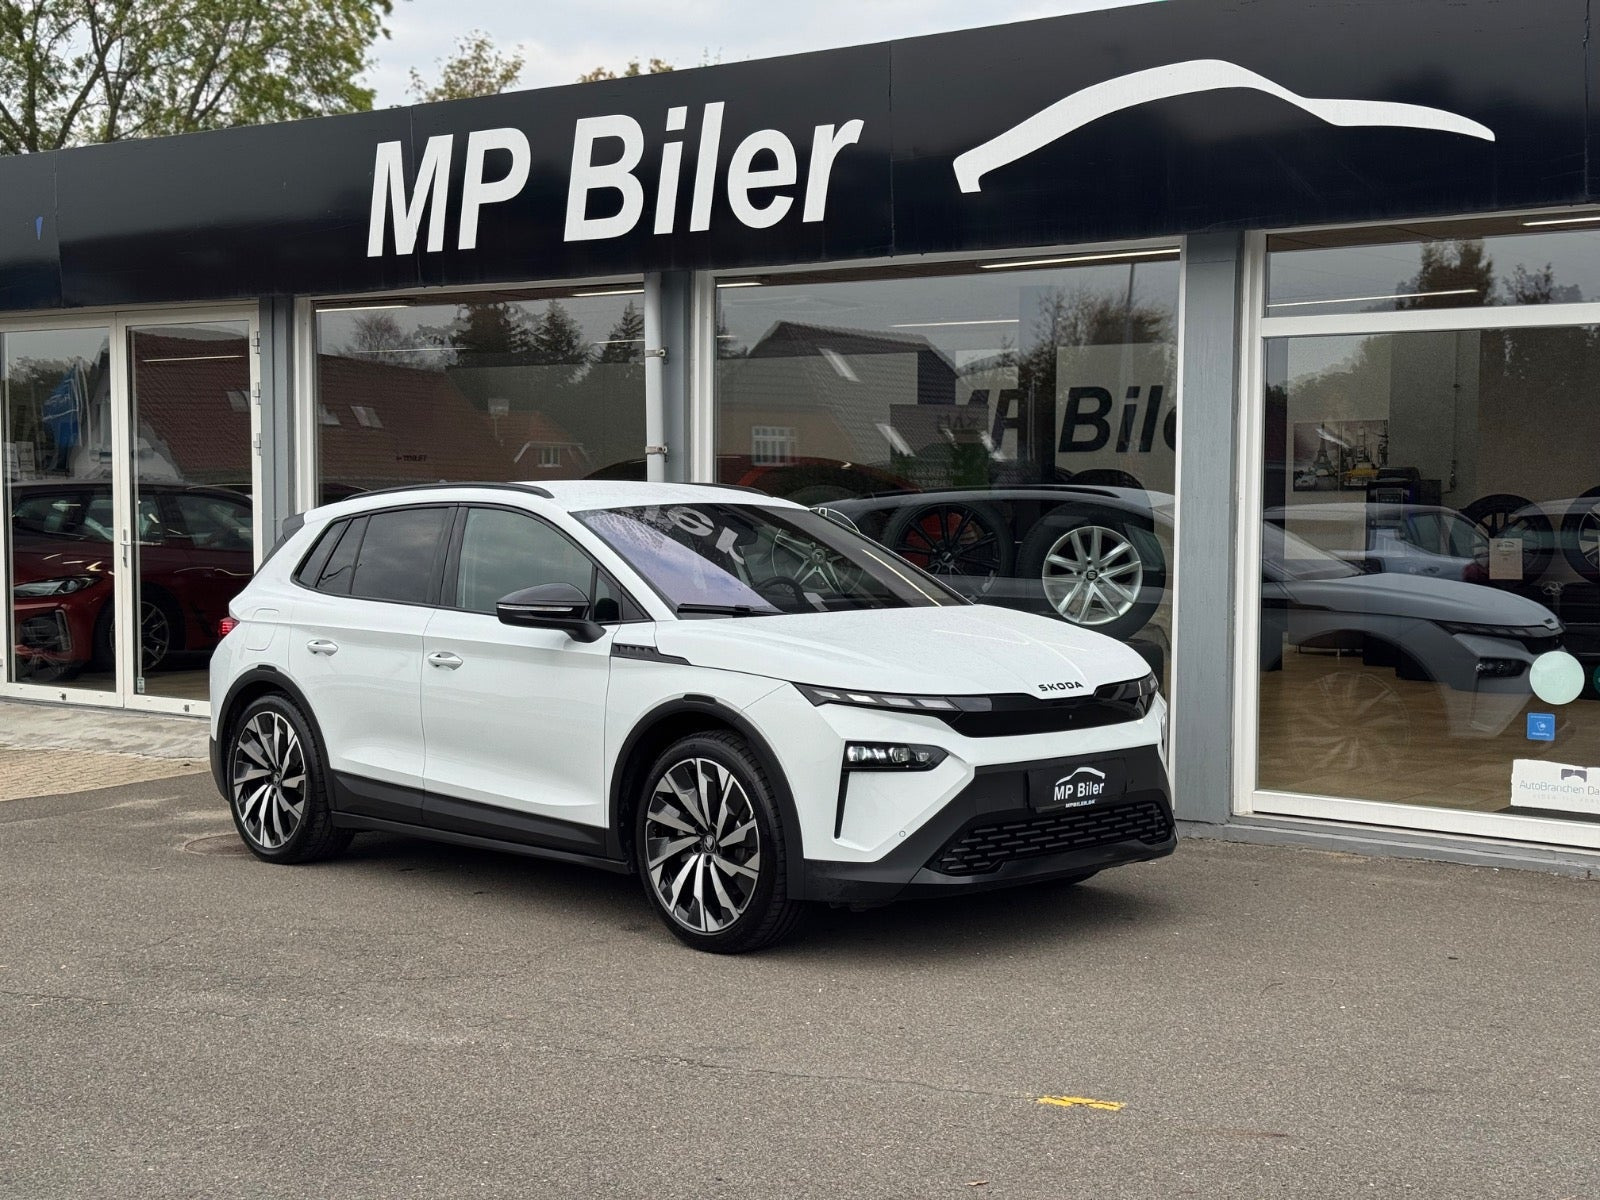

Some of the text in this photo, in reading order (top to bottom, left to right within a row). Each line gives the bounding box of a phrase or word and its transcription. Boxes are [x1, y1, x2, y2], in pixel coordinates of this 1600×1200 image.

[367, 101, 865, 257] MP Biler
[1054, 781, 1105, 801] MP Biler
[1519, 780, 1585, 794] AutoBranchen
